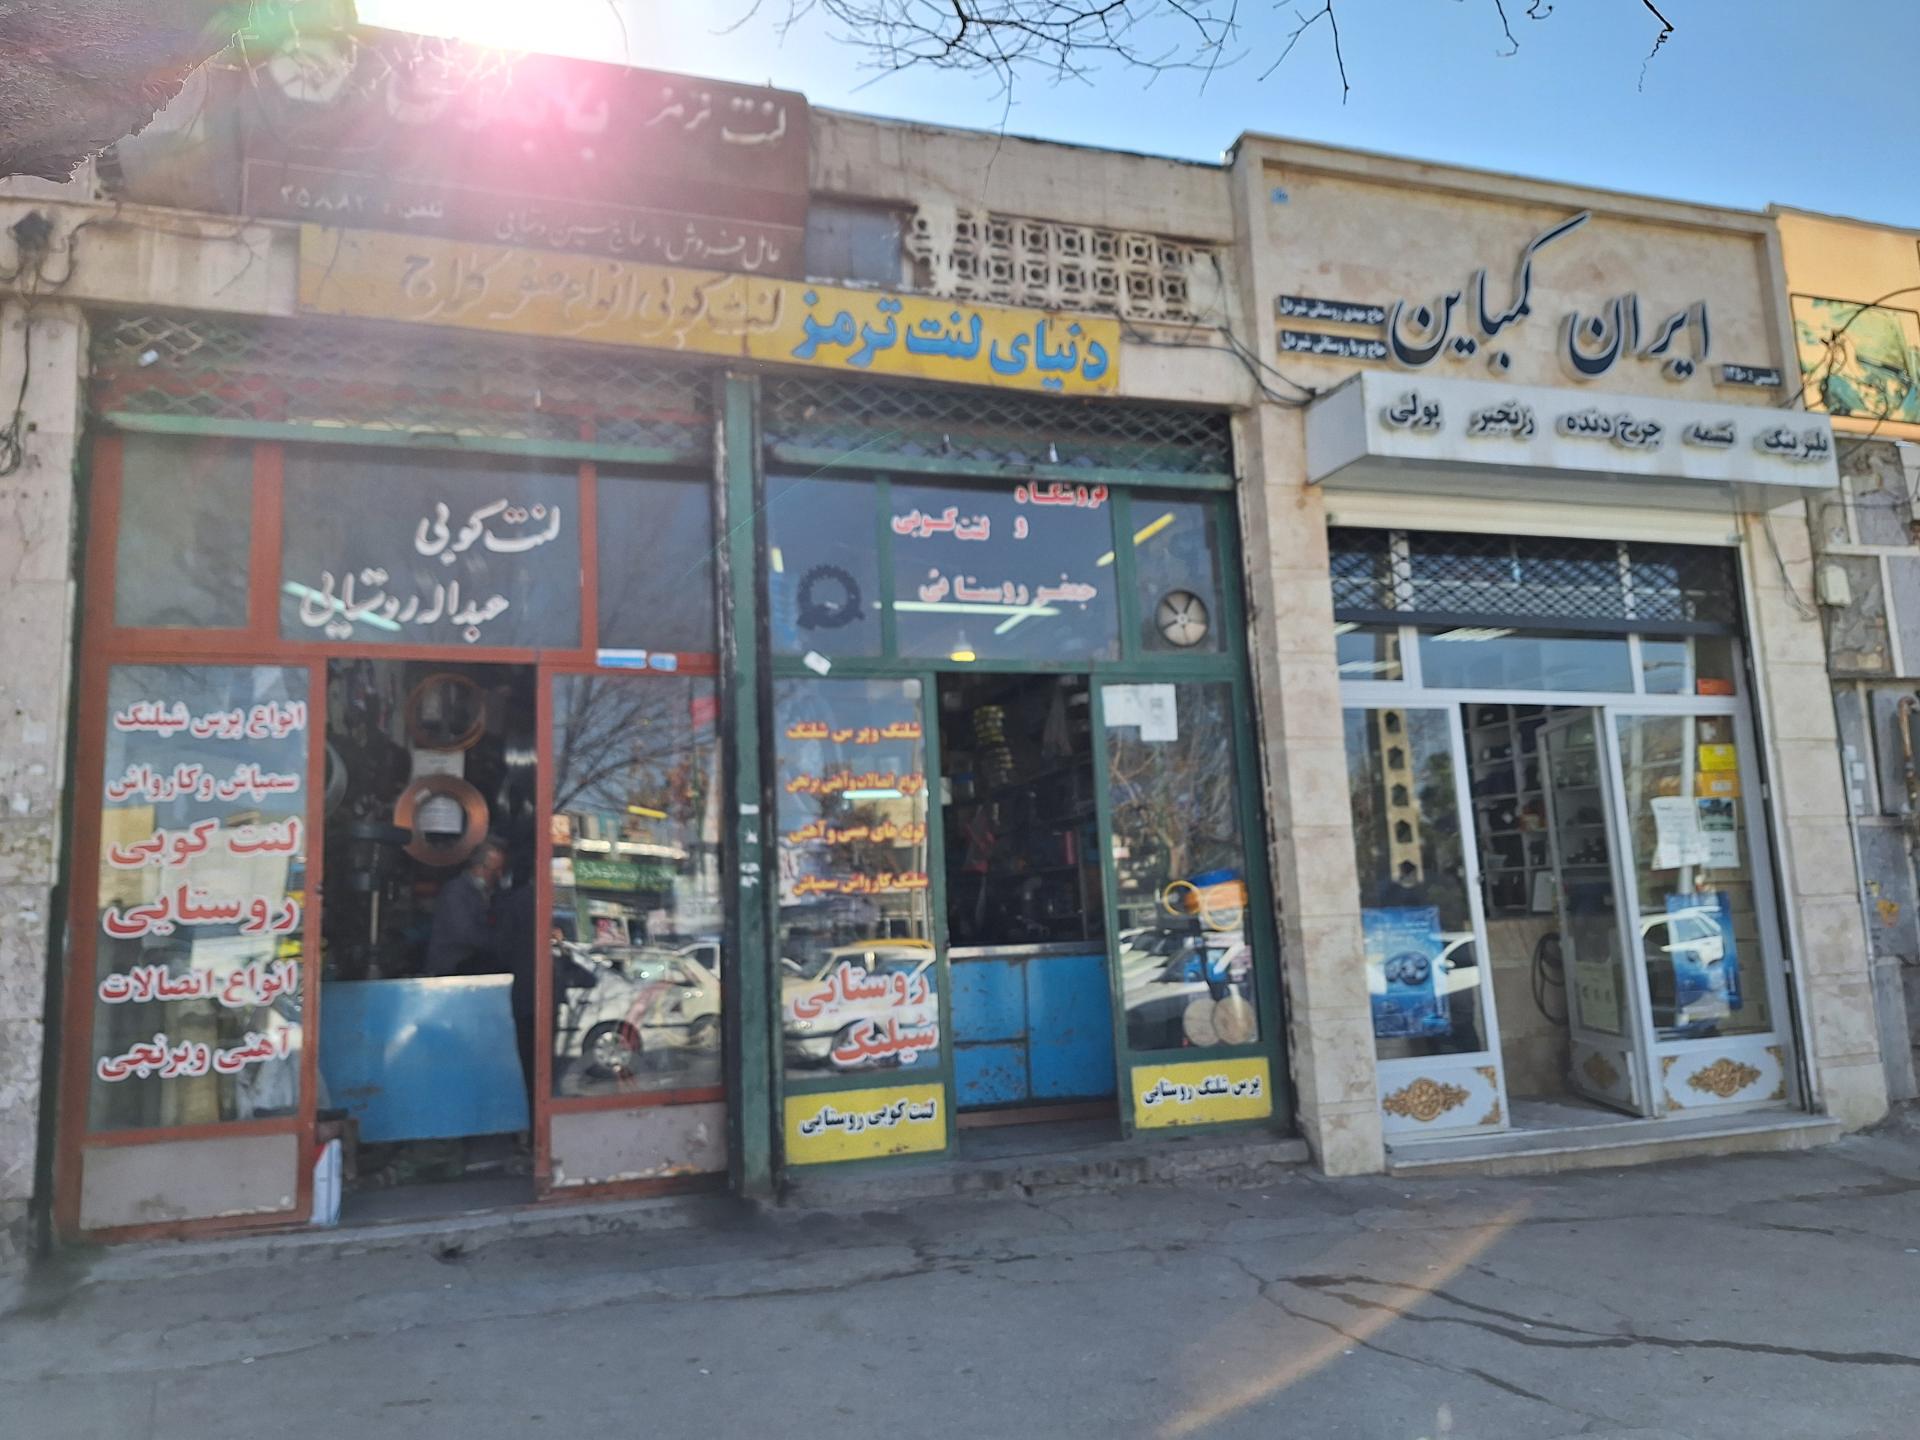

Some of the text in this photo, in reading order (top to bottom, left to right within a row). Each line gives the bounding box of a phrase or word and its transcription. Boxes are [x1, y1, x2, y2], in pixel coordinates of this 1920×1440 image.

[721, 97, 787, 146] لنت
[1388, 209, 1710, 378] ایران کمباین
[791, 291, 1110, 391] دنیای لنت ترمز
[415, 497, 561, 567] لنت کوبی
[954, 511, 991, 541] لنت
[1012, 515, 1029, 540] و
[248, 701, 306, 738] انواع
[106, 815, 304, 868] لنت کوبی
[102, 881, 302, 939] روستایی
[219, 961, 301, 1007] انواع
[791, 958, 930, 1021] روستایی
[212, 1024, 293, 1073] آهنی
[801, 1098, 938, 1136] لنت کوبی روستایی
